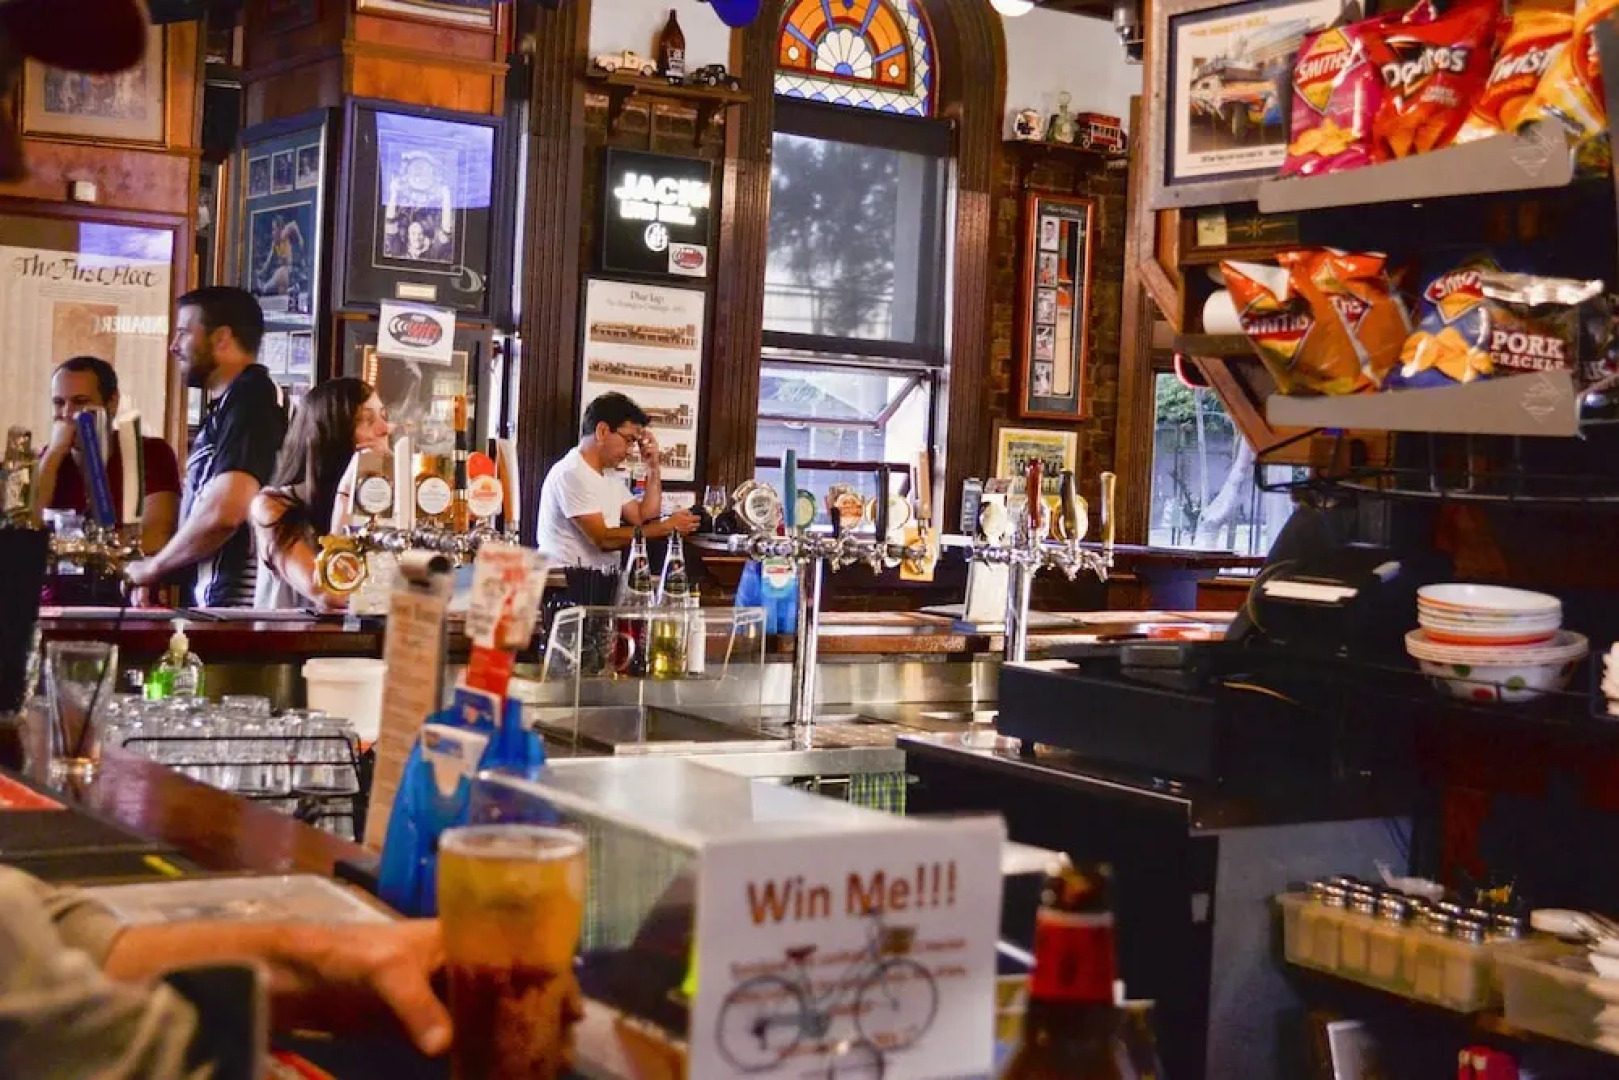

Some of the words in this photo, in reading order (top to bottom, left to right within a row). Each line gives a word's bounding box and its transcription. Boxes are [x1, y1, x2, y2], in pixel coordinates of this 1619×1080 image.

[15, 253, 56, 277] The
[53, 258, 105, 283] First
[1491, 331, 1564, 358] PORK
[747, 875, 831, 926] Win
[846, 860, 957, 916] Me!!!
